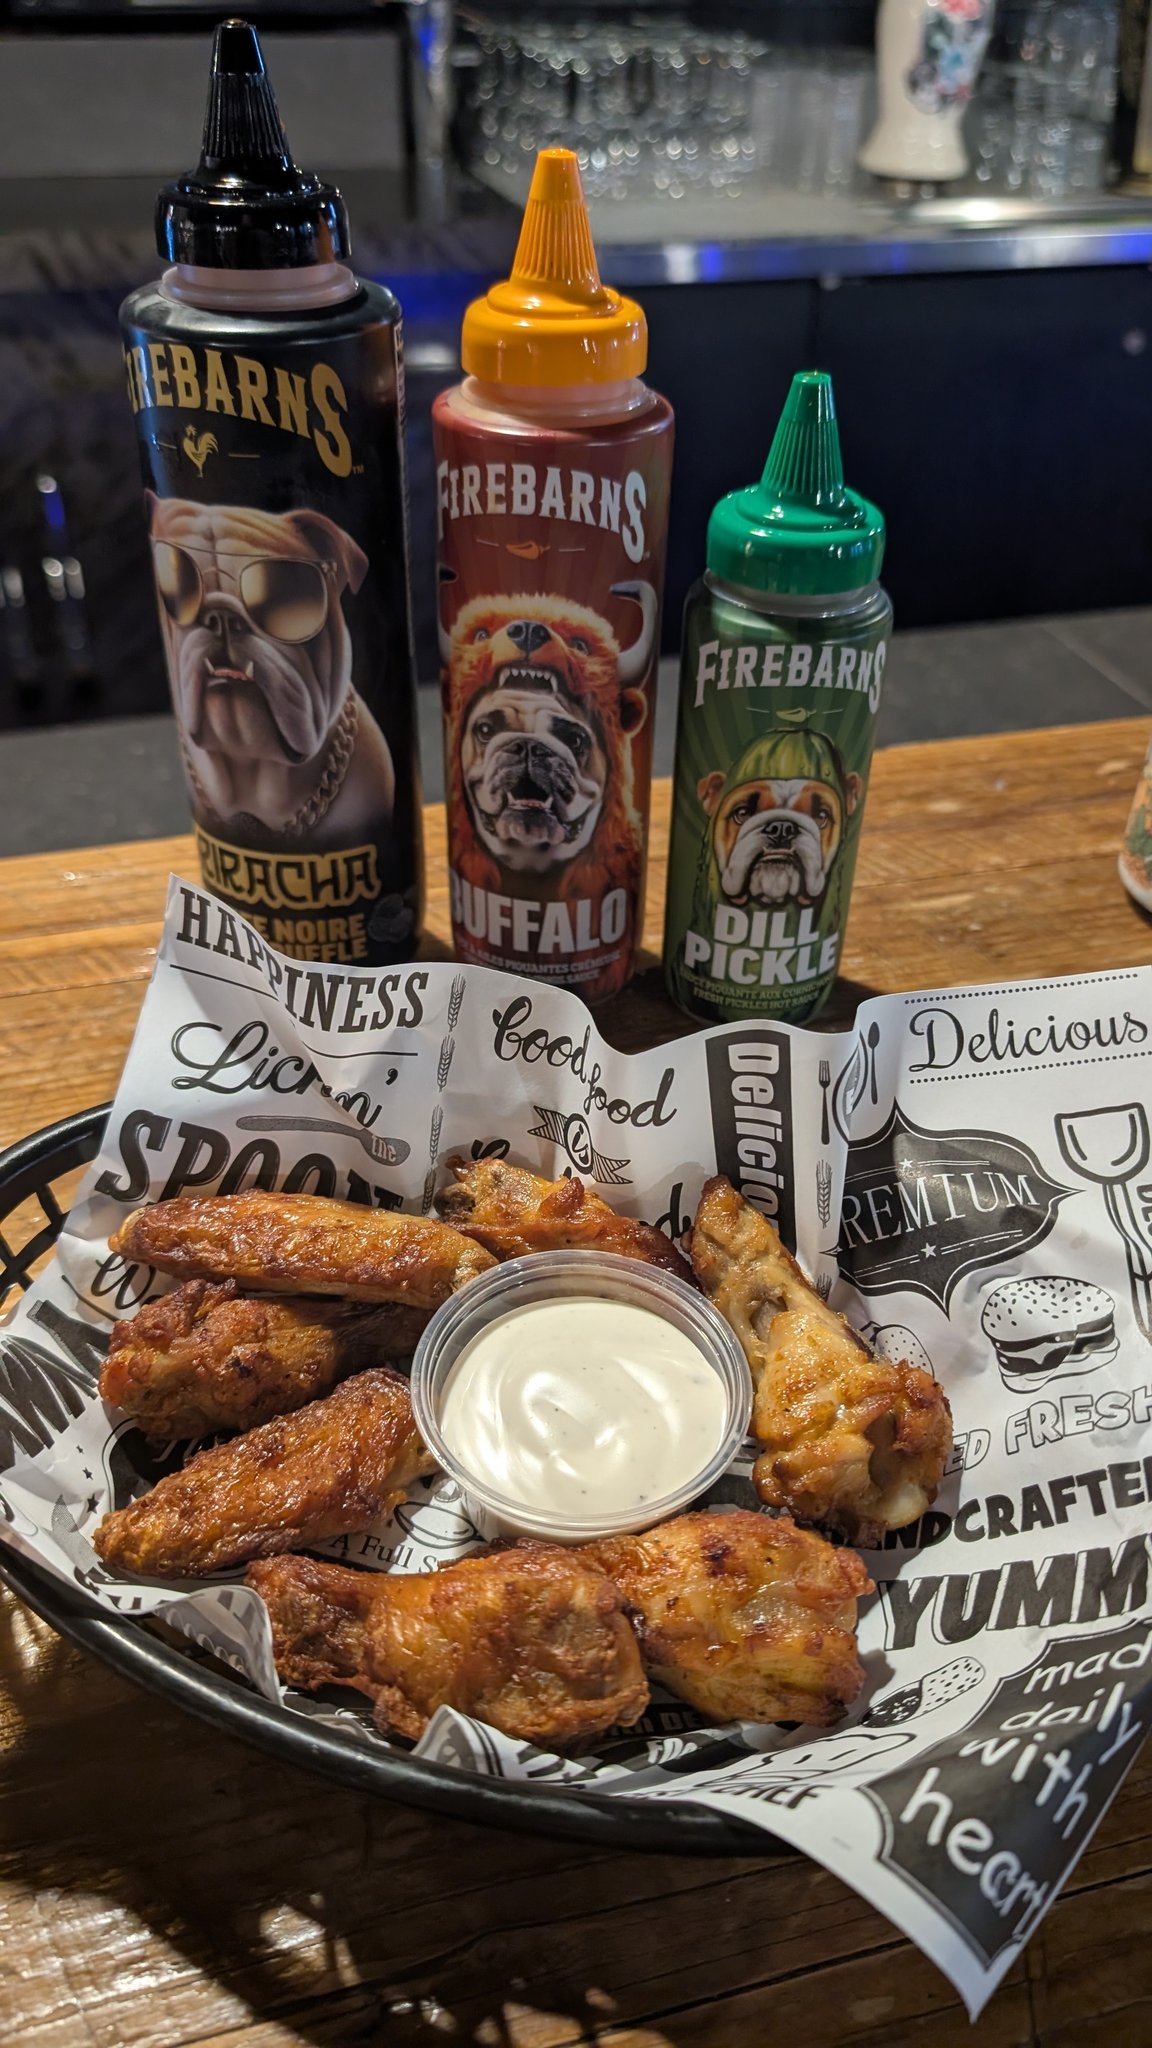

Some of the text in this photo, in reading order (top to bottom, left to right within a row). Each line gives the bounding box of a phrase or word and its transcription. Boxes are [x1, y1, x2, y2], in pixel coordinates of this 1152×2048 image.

[123, 343, 351, 478] IREBARNS
[437, 460, 646, 563] FIREBARNS
[694, 640, 886, 714] FIREBARNS
[273, 913, 365, 944] NOIRE
[684, 929, 839, 986] PICKLE
[714, 903, 819, 948] DILL
[176, 886, 429, 1033] HAPPINESS
[725, 996, 768, 1010] PICKLES
[769, 998, 791, 1009] HOT
[759, 989, 781, 1000] AUX
[909, 1008, 1148, 1073] Delicious
[583, 1063, 677, 1127] food
[728, 1042, 784, 1232] Delicio
[840, 1171, 1041, 1249] REMIUM
[328, 1533, 349, 1552] A
[358, 1534, 414, 1569] Full
[877, 1533, 1152, 1651] YUMM
[1023, 1631, 1152, 1694] mad
[999, 1681, 1142, 1766] daily
[710, 1783, 834, 1809] CHEF
[959, 1732, 1093, 1840] with
